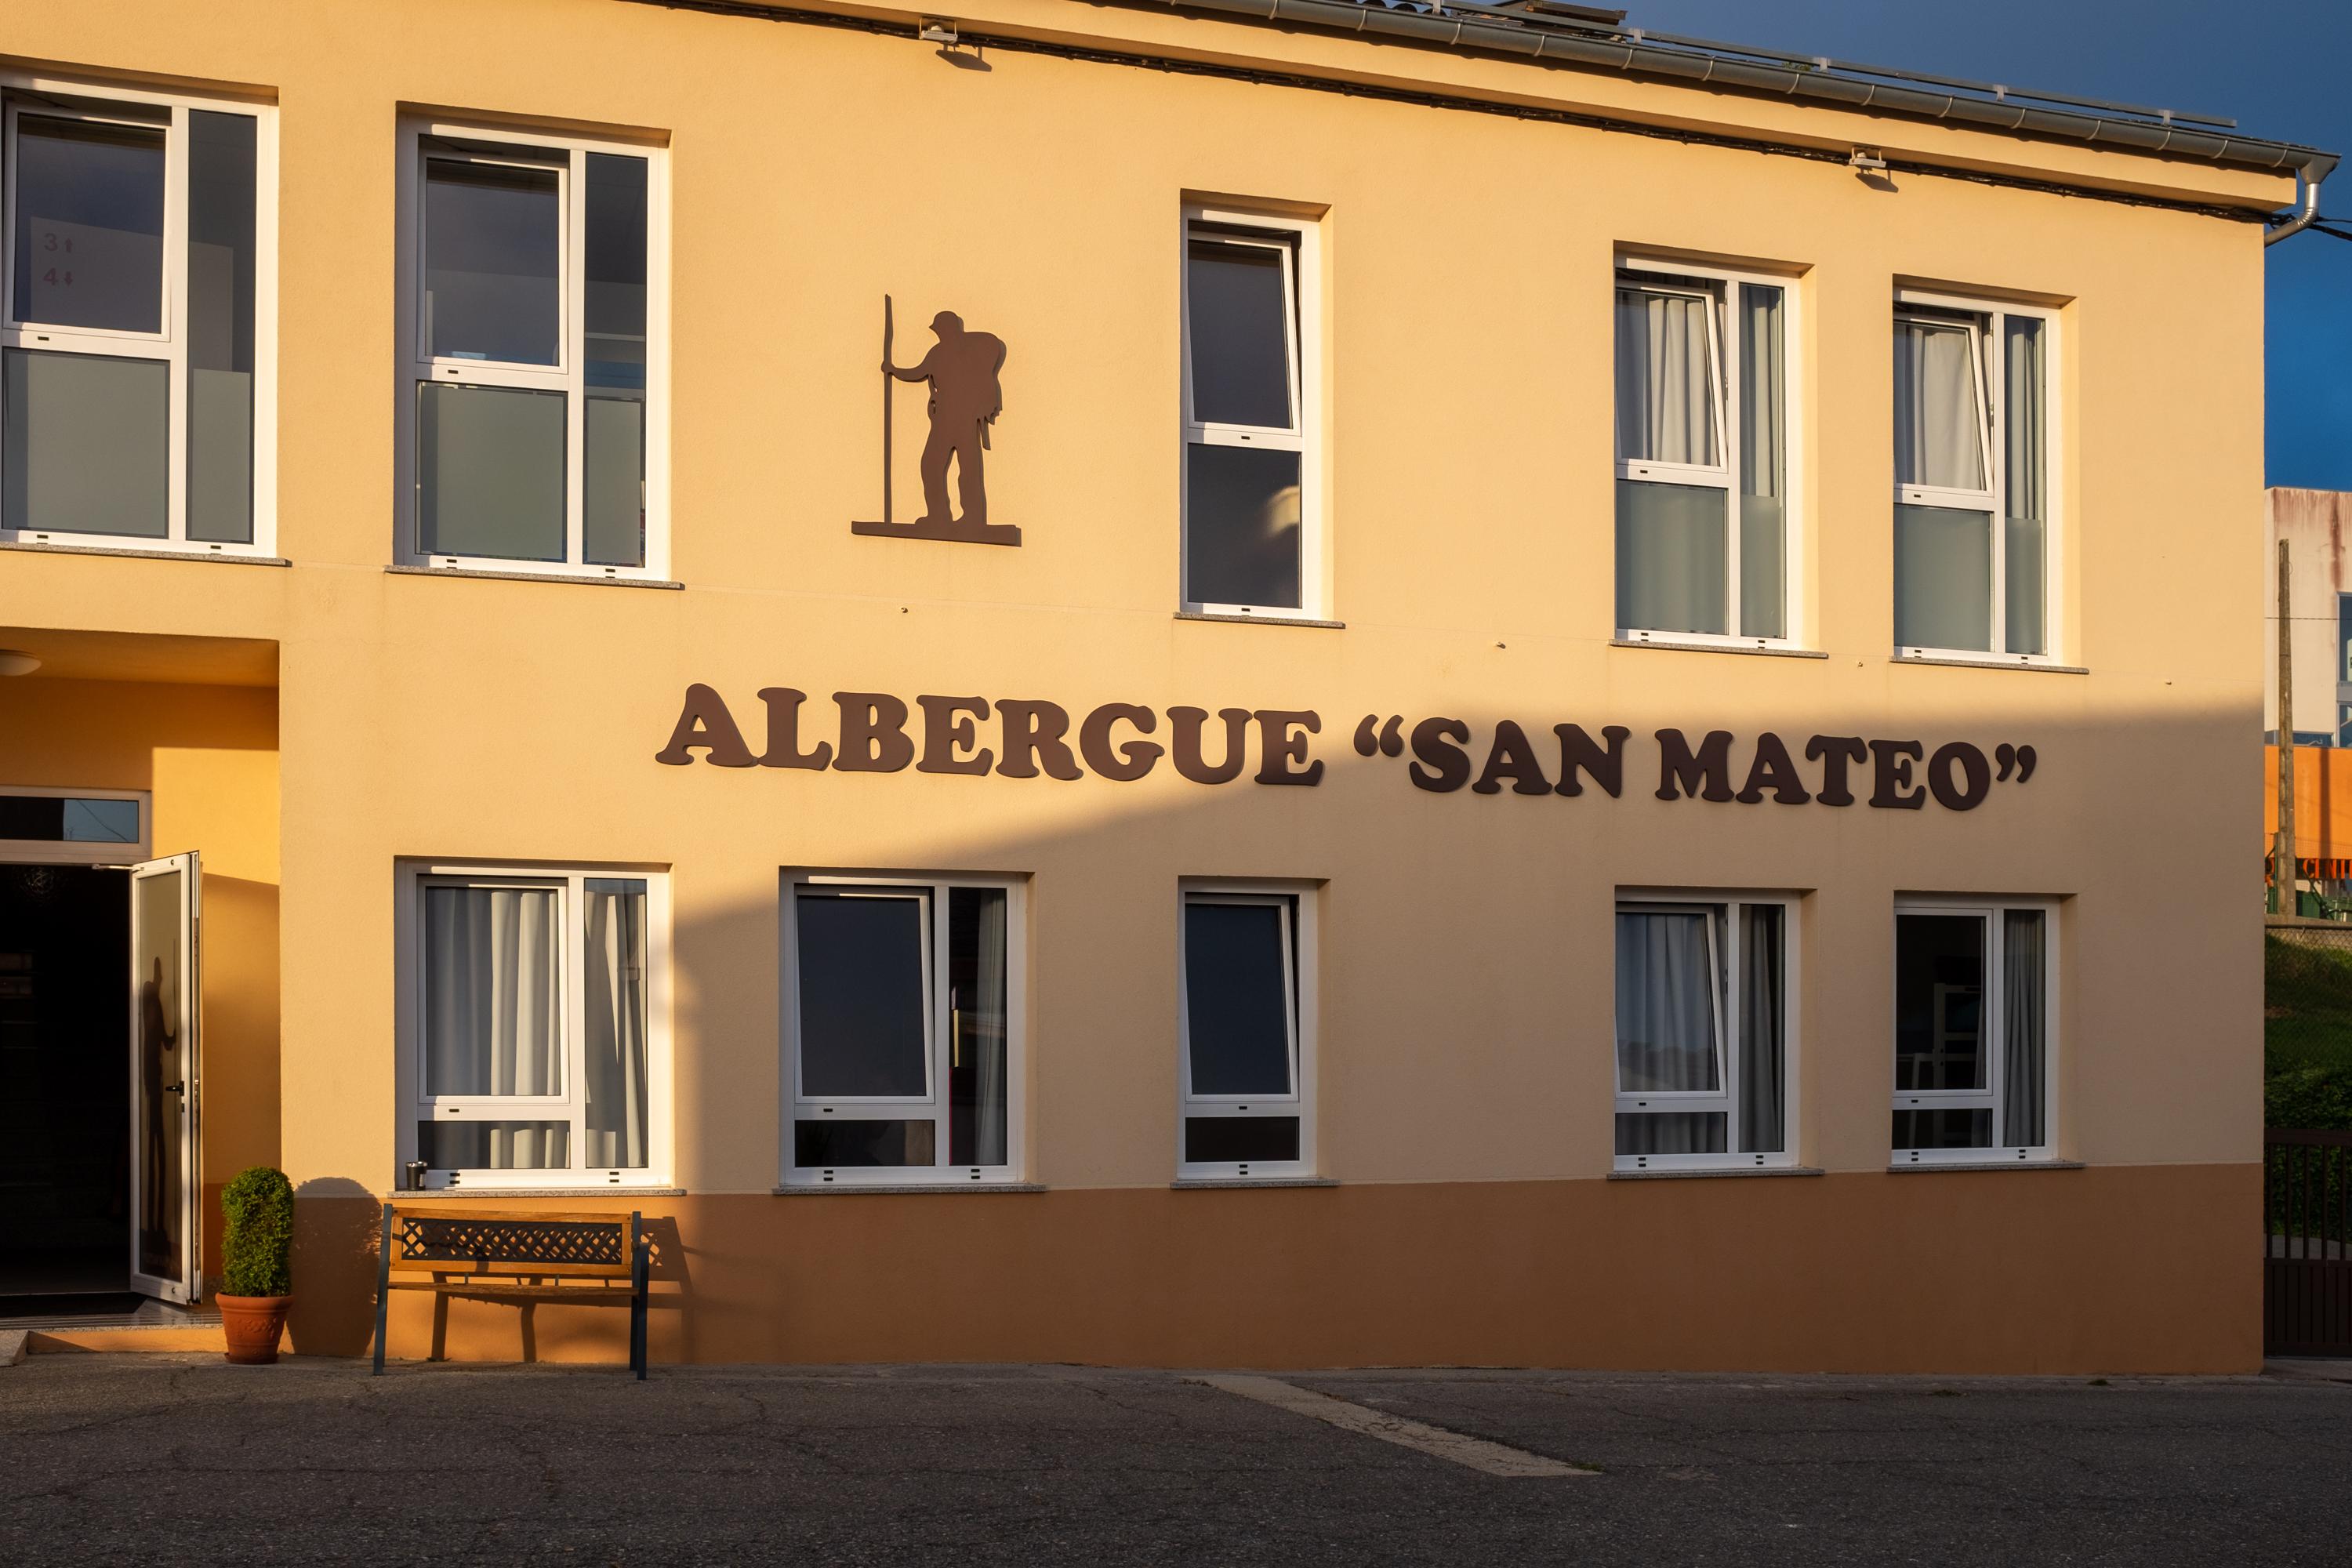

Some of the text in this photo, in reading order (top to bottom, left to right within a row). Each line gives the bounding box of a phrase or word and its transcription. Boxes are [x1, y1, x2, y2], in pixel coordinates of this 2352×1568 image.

[44, 232, 58, 251] 3
[43, 267, 59, 285] 4
[654, 682, 2038, 812] ALBERGUE “SAN MATEO”
